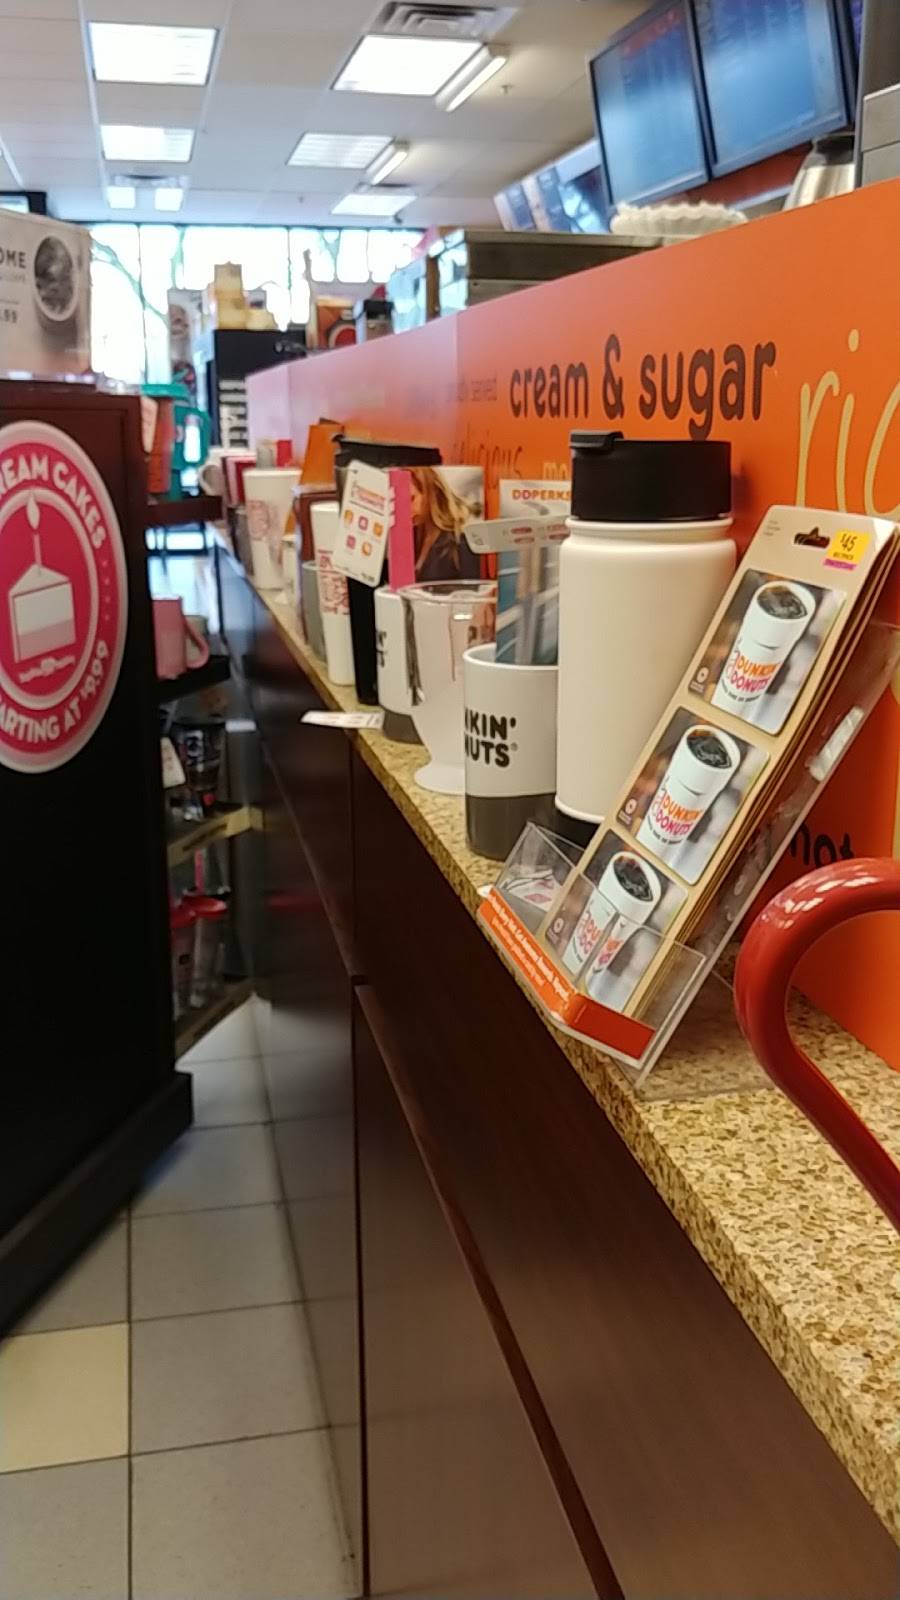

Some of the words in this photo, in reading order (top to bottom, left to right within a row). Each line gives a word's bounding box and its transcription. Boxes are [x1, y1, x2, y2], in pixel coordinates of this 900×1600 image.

[509, 362, 589, 419] cream
[602, 333, 625, 420] &
[638, 341, 777, 440] sugar
[53, 462, 106, 549] CAKES
[64, 697, 81, 733] AT
